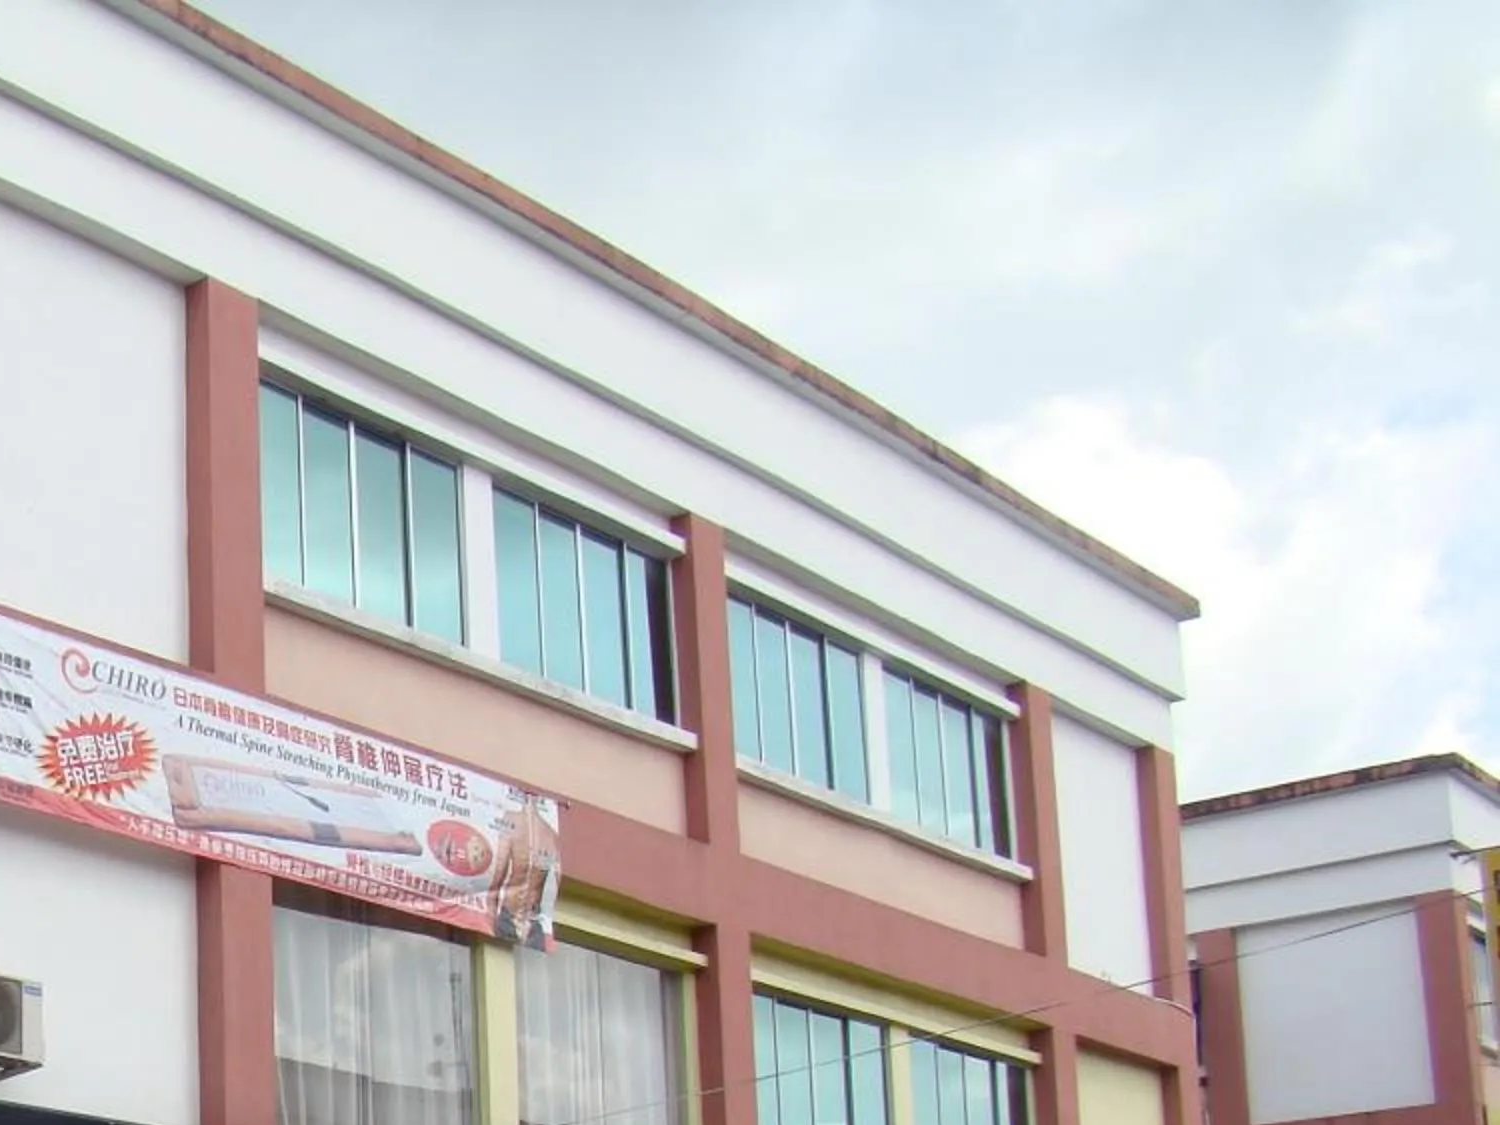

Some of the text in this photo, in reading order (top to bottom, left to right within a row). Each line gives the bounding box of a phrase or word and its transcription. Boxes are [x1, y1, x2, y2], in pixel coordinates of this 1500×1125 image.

[62, 762, 108, 789] FREE
[186, 716, 238, 744] Thermal
[240, 733, 275, 755] Spine
[276, 743, 335, 778] Stretching
[336, 763, 411, 801] Physiotherapy
[411, 787, 438, 808] from
[439, 797, 471, 818] Japan
